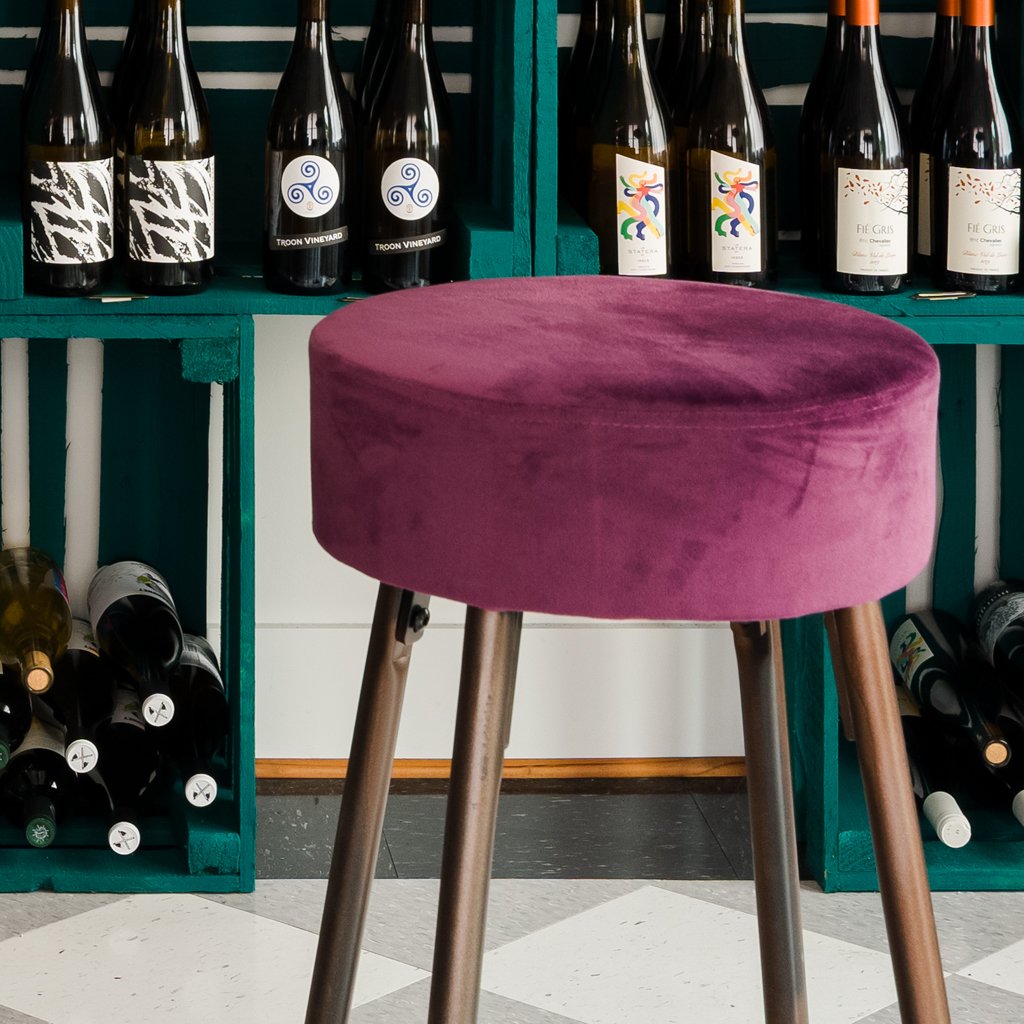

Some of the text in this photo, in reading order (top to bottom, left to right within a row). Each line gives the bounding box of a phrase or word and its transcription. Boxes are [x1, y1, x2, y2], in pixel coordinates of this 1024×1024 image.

[872, 224, 894, 234] GRIS
[983, 224, 1005, 234] GRIS
[276, 232, 343, 247] TROON VINEYARD
[375, 235, 441, 251] TROON VINEYARD
